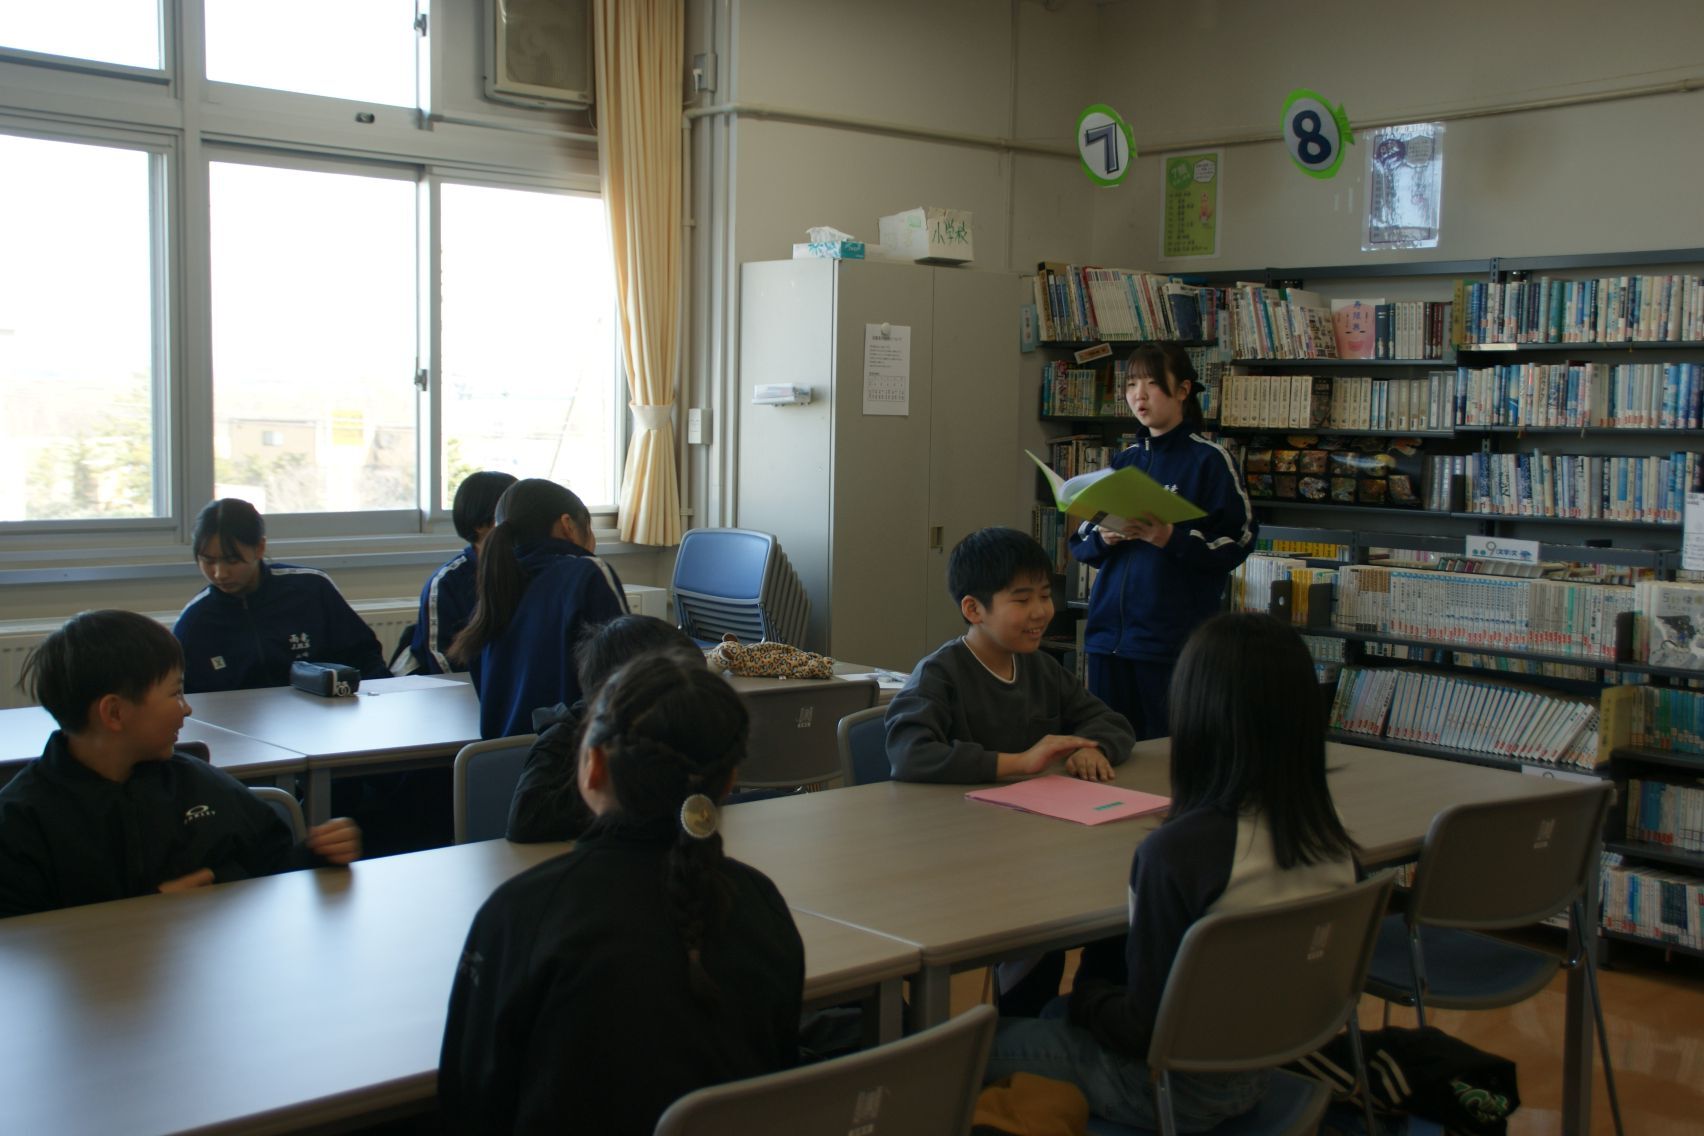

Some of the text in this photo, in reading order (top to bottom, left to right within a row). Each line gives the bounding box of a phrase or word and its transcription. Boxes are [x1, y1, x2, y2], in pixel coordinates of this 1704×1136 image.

[1085, 122, 1120, 175] 7
[1292, 109, 1332, 165] 8
[932, 218, 969, 245] 小学校
